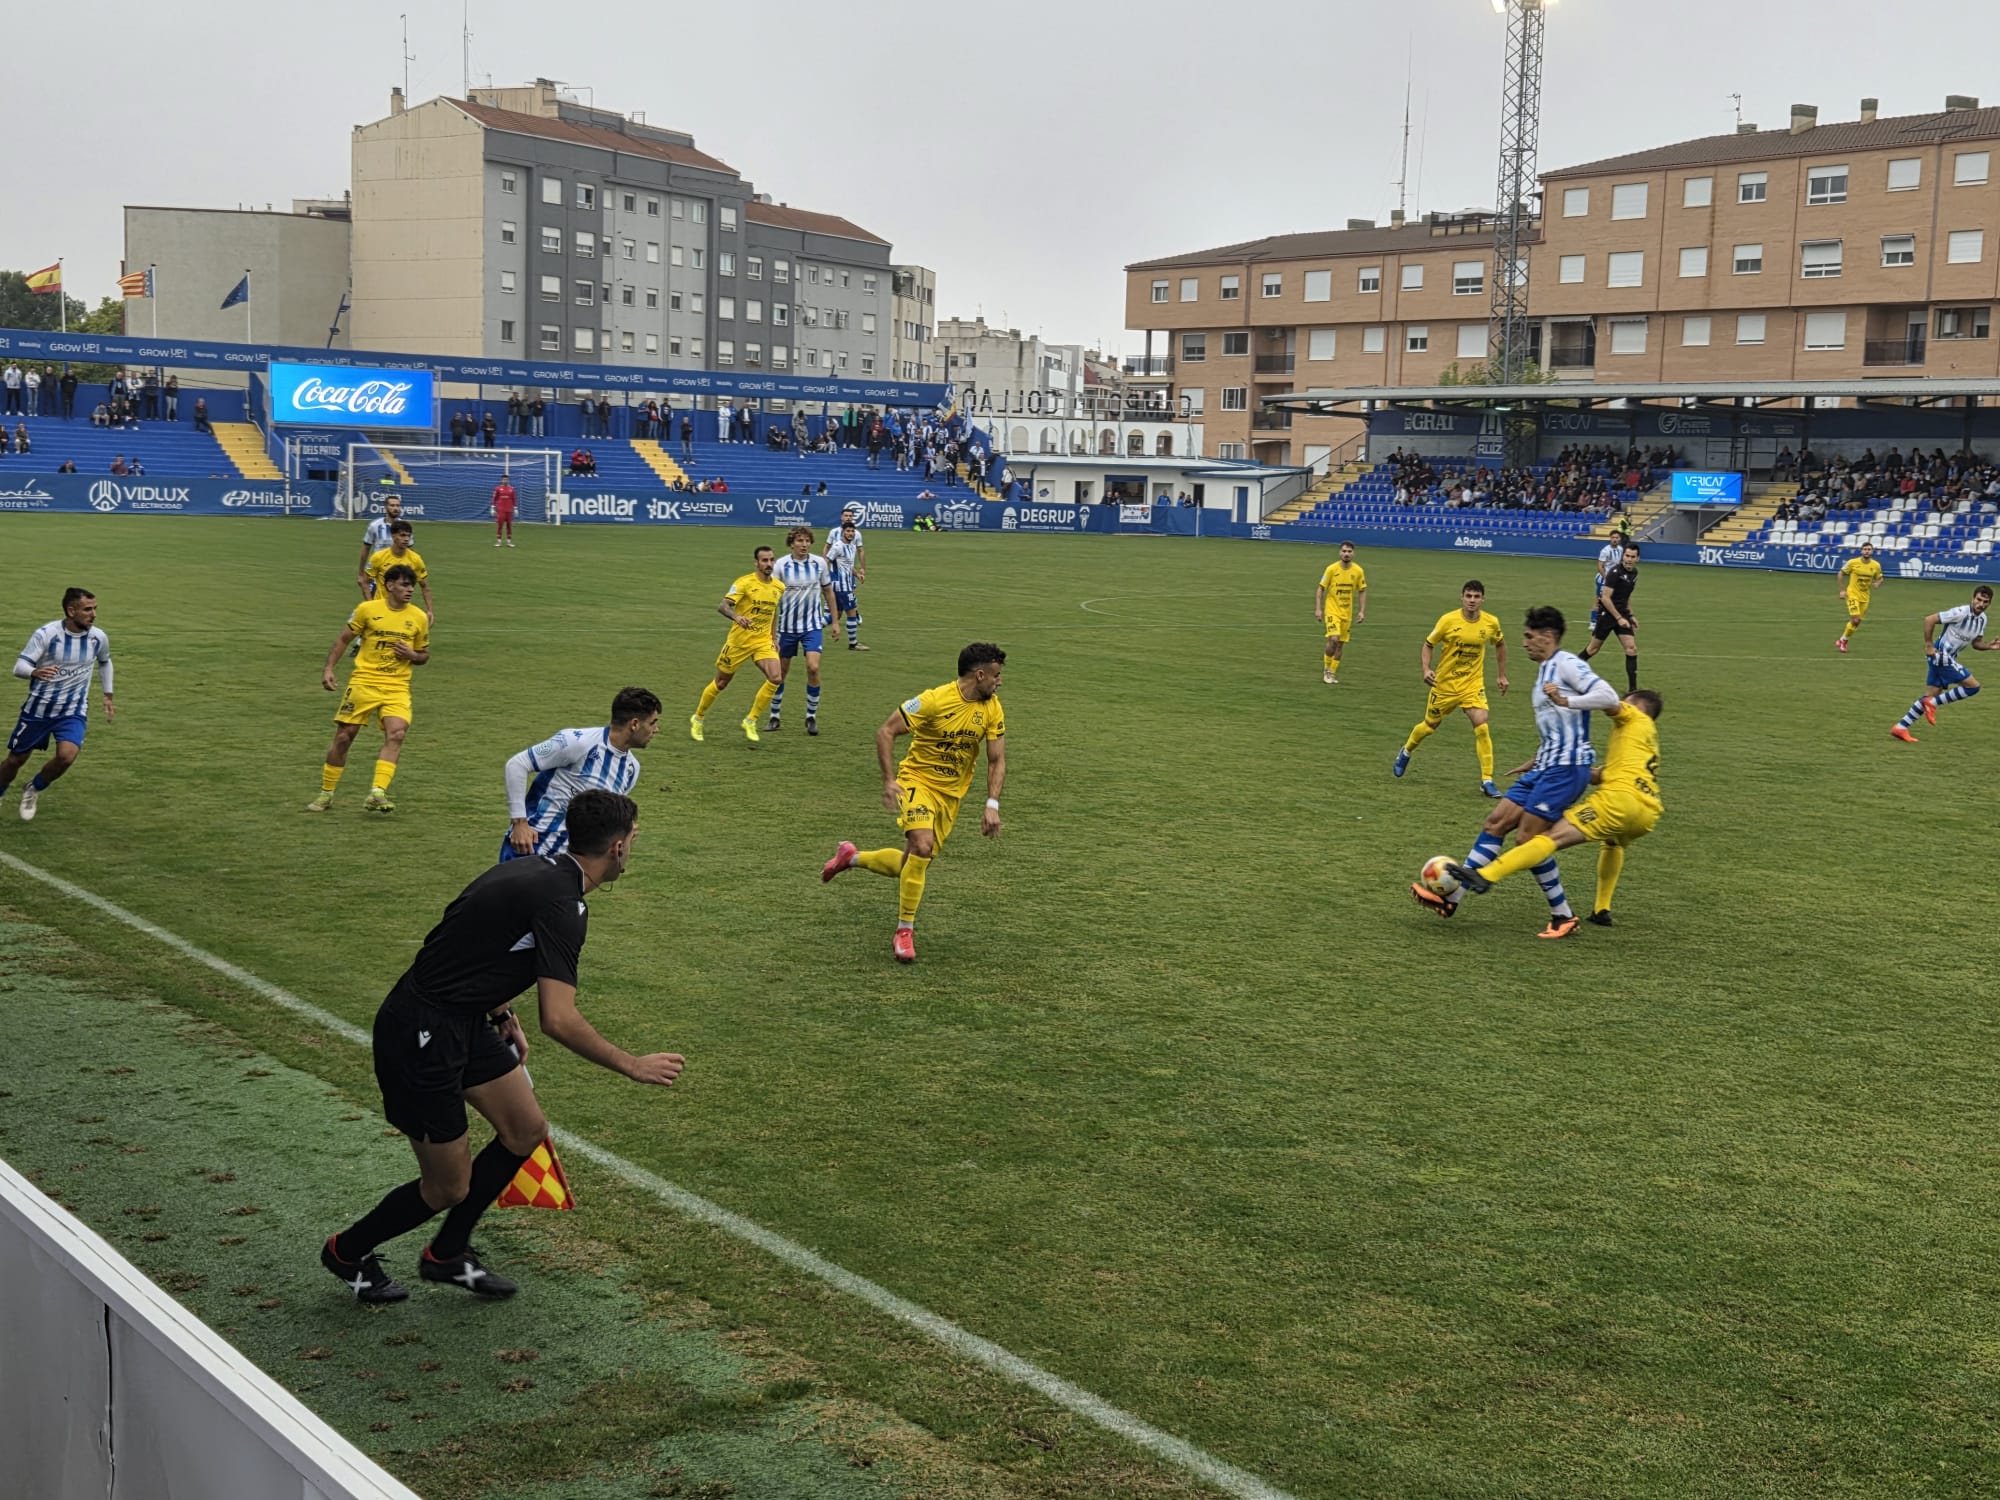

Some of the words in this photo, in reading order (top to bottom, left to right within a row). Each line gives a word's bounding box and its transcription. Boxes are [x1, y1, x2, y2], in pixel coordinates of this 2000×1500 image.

[49, 343, 81, 353] GROW
[82, 343, 100, 353] UP!
[139, 348, 169, 357] GROW
[170, 348, 188, 358] UP!
[224, 353, 254, 362] GROW
[255, 353, 271, 363] UP!
[461, 366, 488, 375] GROW
[533, 371, 558, 380] GROW
[604, 374, 628, 383] GROW
[673, 379, 697, 387] GROW
[738, 382, 761, 390] GROW
[803, 385, 825, 393] GROW
[292, 377, 413, 414] Coca-Cola
[864, 389, 886, 397] GROW
[1684, 476, 1726, 487] VERICAT
[123, 486, 190, 502] VIDLUX
[571, 494, 638, 516] netllar
[680, 502, 733, 513] SYSTEM
[756, 498, 810, 514] VERICAT
[867, 501, 902, 514] Mutua
[866, 512, 904, 522] Levante
[1021, 508, 1076, 524] DEGRUP
[1463, 536, 1493, 549] Replus
[1723, 550, 1766, 560] SYSTEM
[1786, 552, 1840, 570] VERICAT
[1923, 561, 1980, 574] Tecnovasol
[16, 722, 28, 737] 7
[906, 787, 916, 803] 7
